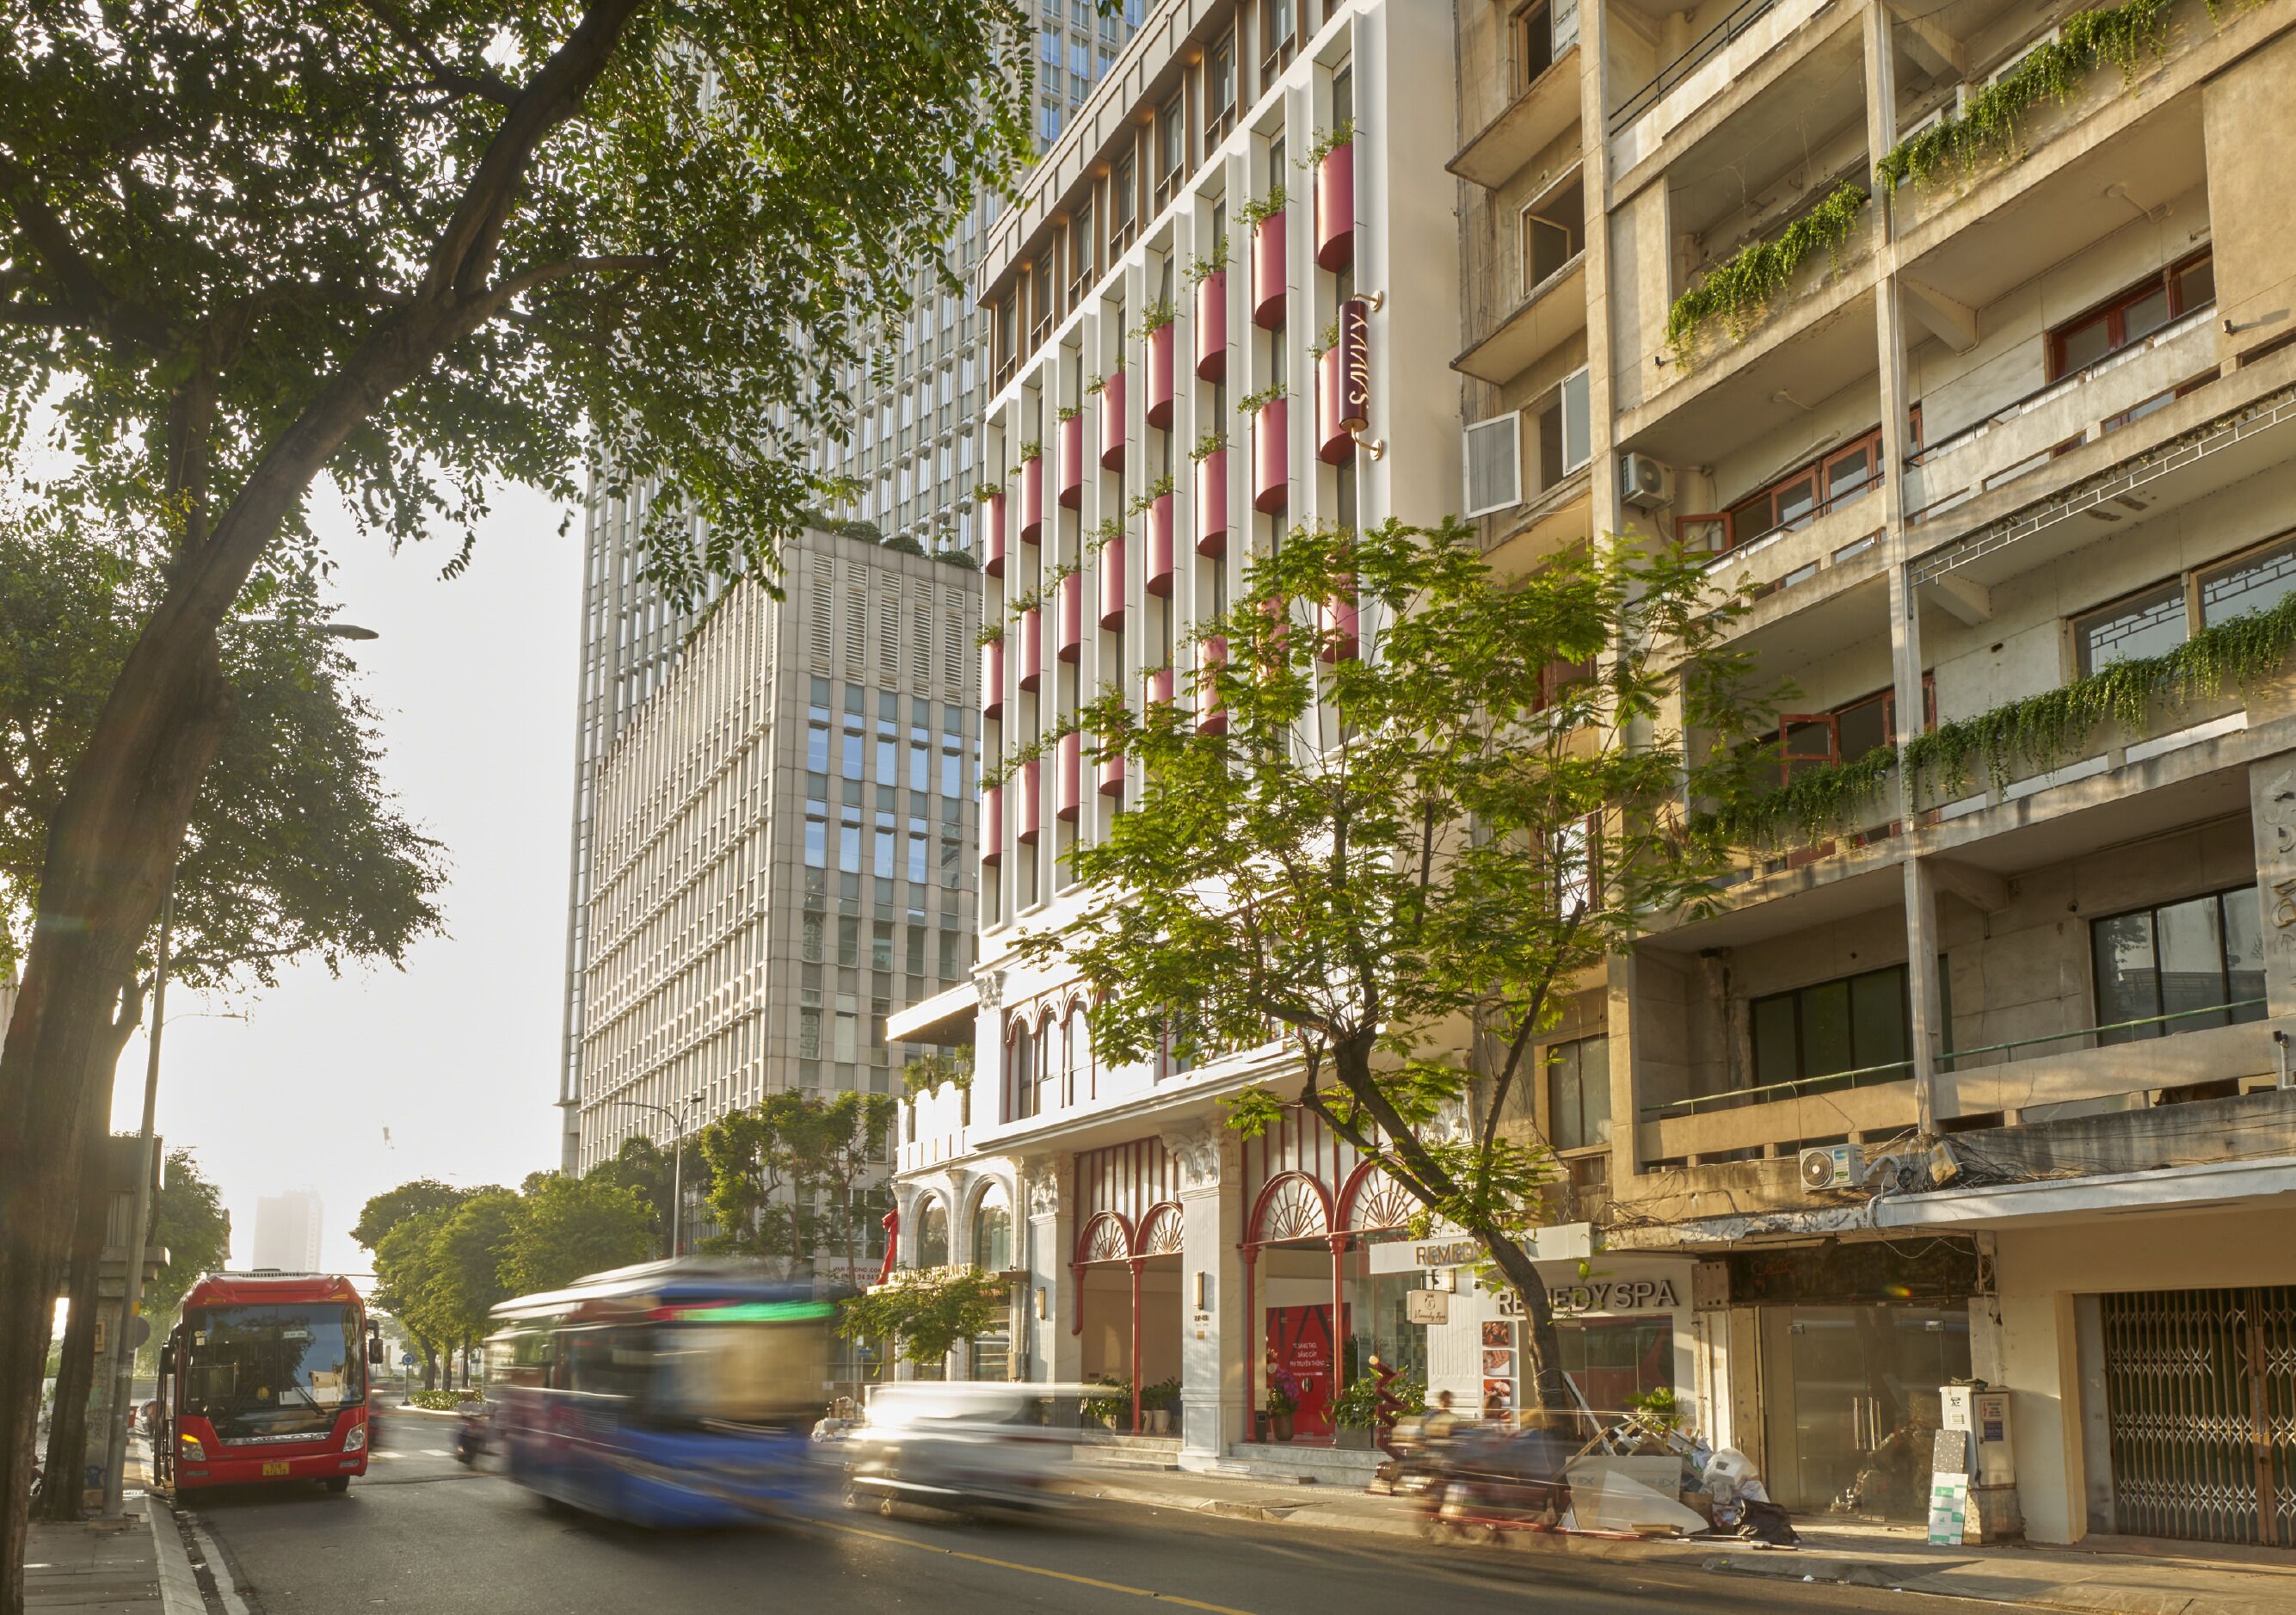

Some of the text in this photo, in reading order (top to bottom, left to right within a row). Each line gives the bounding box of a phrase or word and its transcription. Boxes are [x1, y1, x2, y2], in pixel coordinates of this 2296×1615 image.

[1349, 313, 1369, 410] SAVVY
[1497, 1279, 1679, 1314] REEDY SPA
